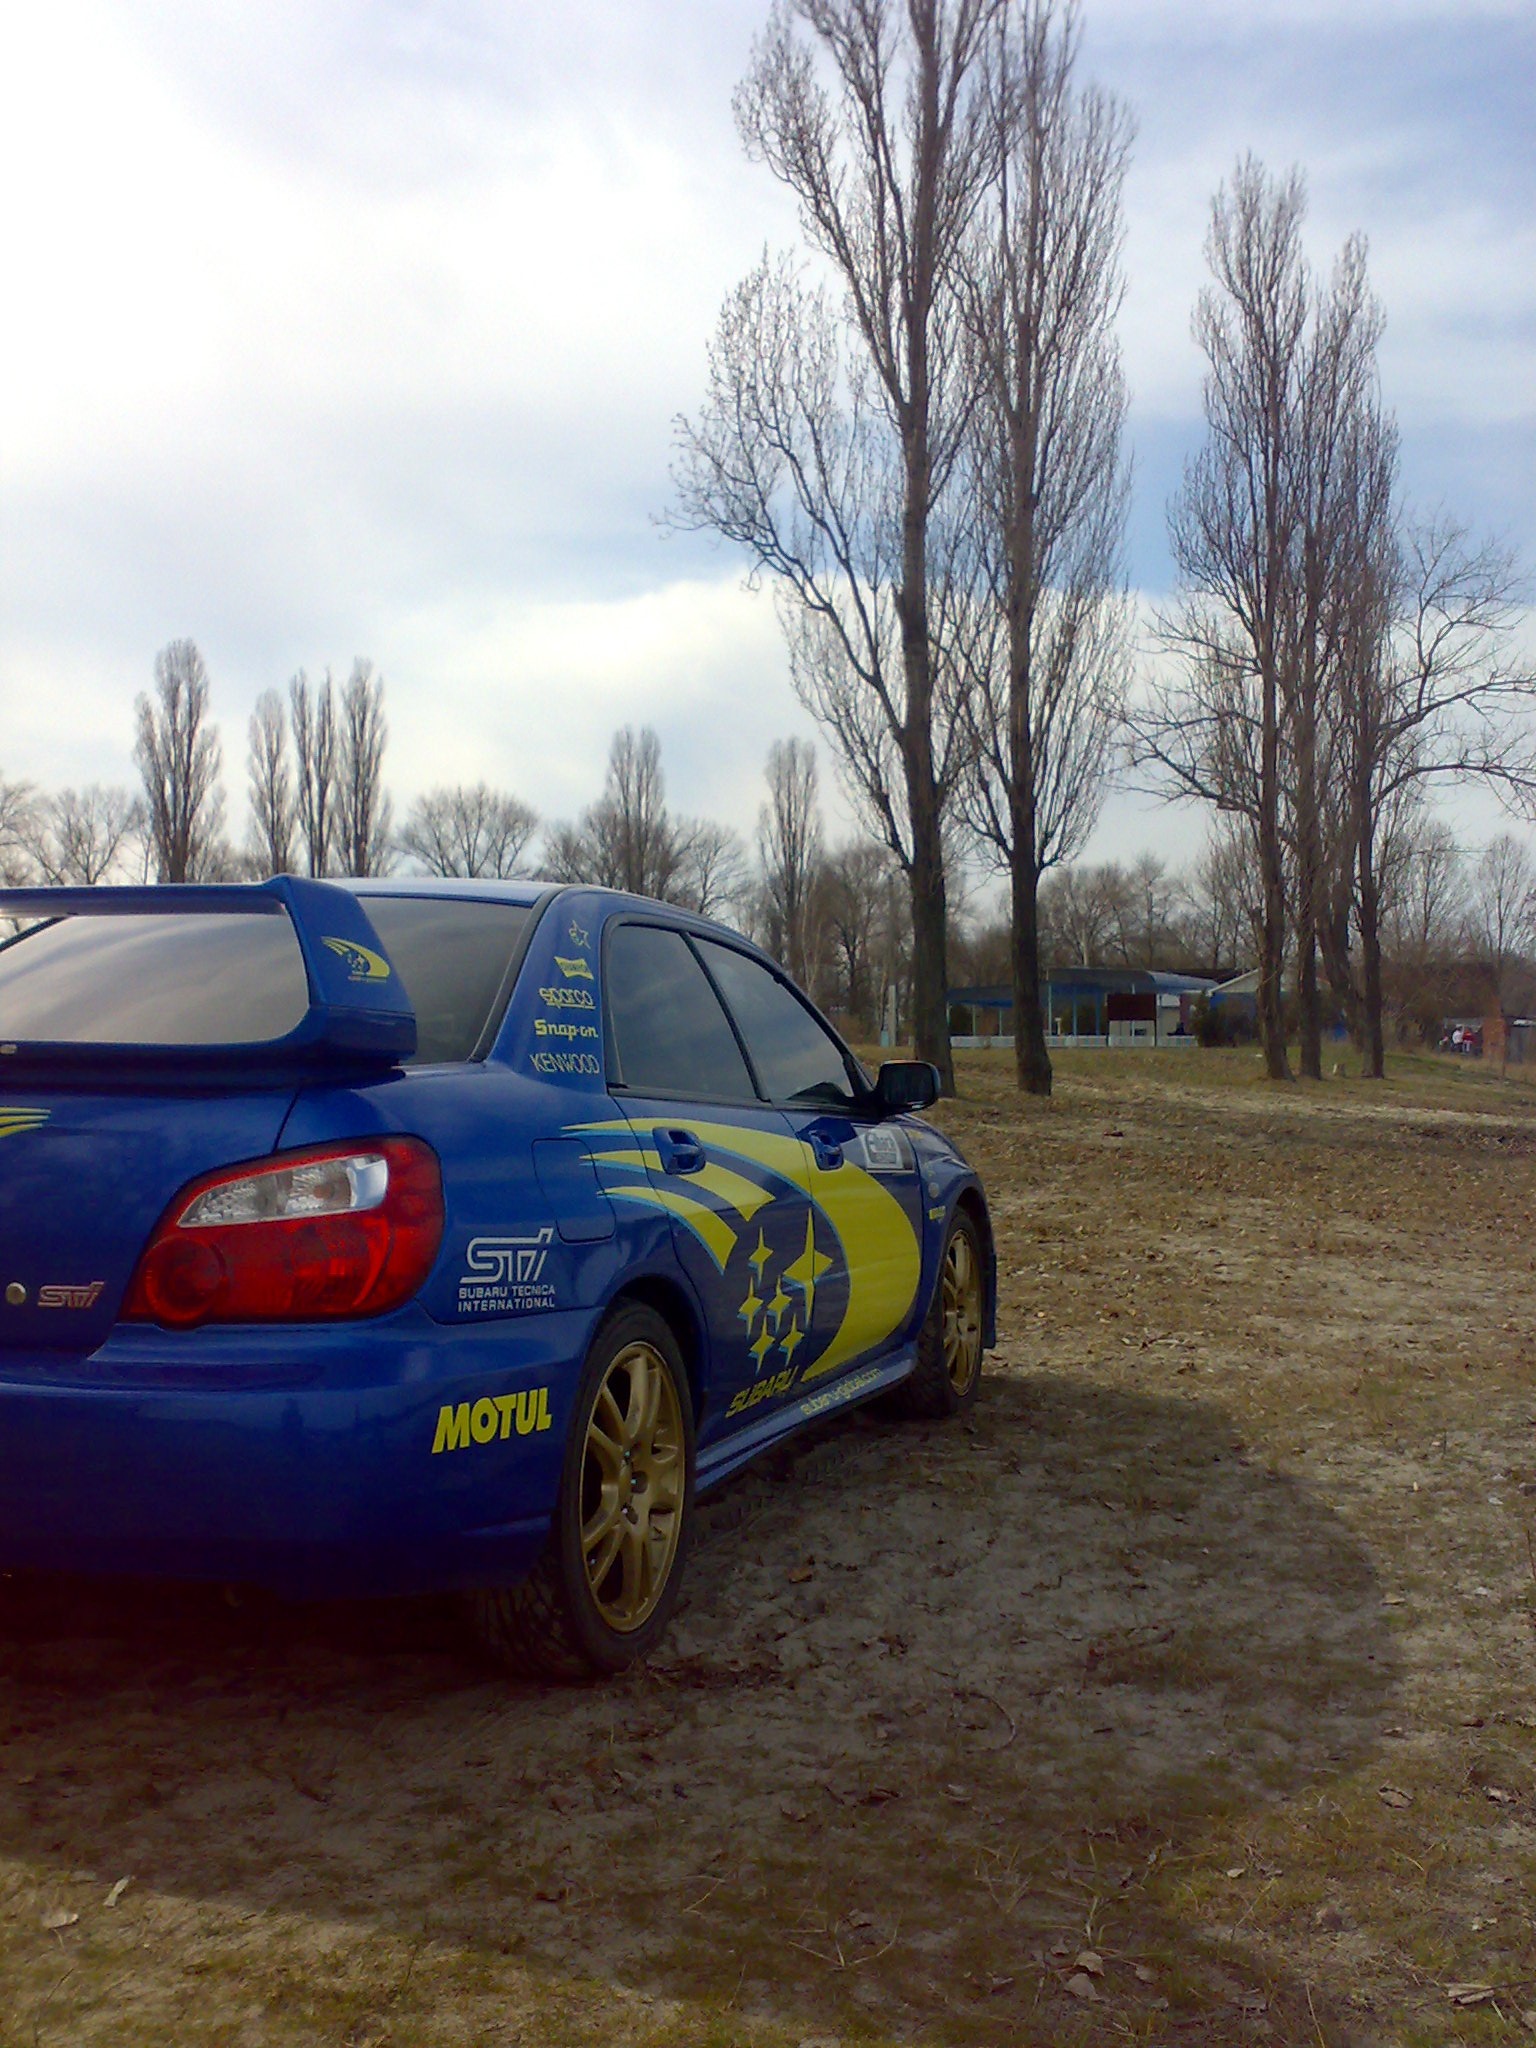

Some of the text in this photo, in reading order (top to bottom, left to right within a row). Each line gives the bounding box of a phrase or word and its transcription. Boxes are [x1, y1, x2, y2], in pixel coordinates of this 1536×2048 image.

[534, 1019, 599, 1041] Snap-on
[529, 1053, 600, 1074] KENWOOD
[458, 1284, 556, 1299] SUBARU TECNICA
[457, 1297, 556, 1313] INTERNATIONAL
[725, 1364, 800, 1419] SUBARU
[431, 1386, 552, 1455] MOTUL
